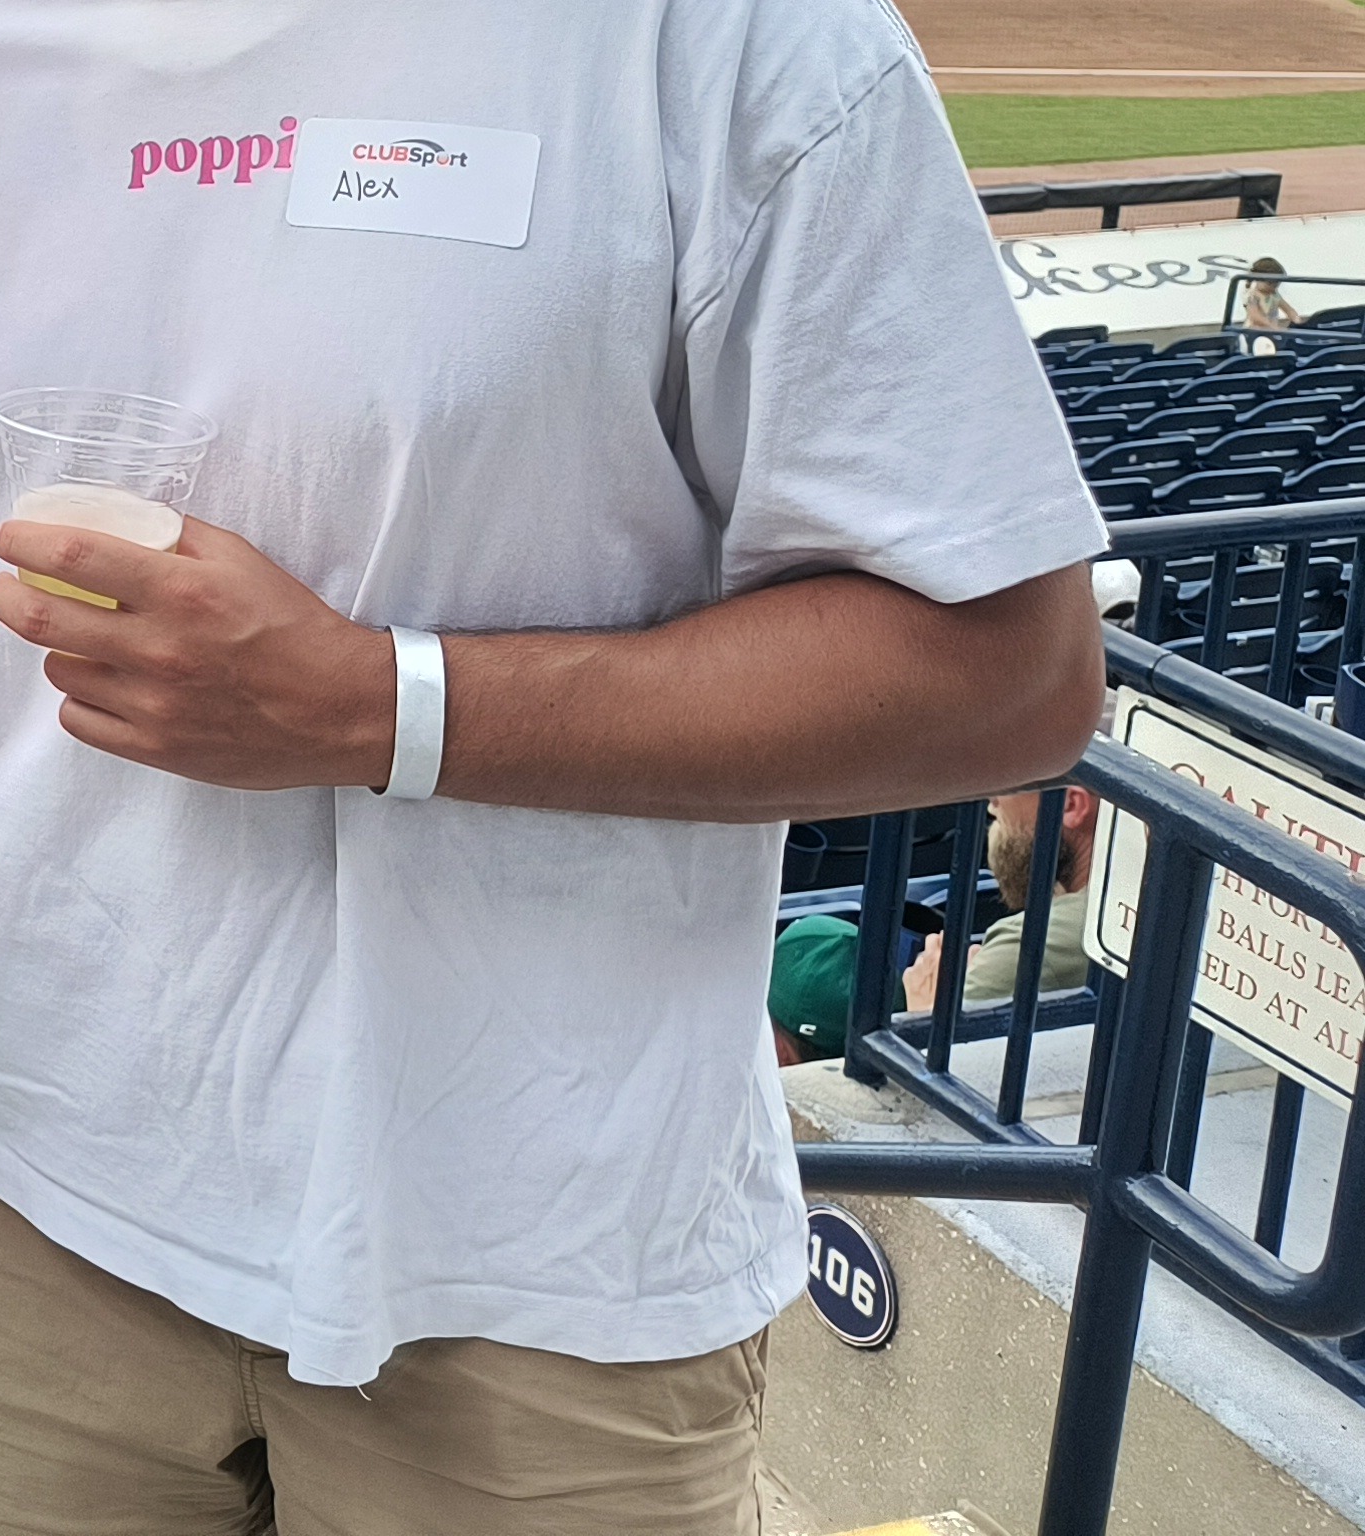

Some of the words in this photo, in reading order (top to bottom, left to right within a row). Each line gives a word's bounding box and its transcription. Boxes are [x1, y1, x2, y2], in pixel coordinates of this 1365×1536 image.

[127, 115, 298, 190] poppi
[332, 169, 400, 202] Alex
[352, 140, 469, 168] CLUBSport
[1217, 908, 1307, 980] BALLS
[1201, 950, 1258, 1001] ELD
[1263, 991, 1308, 1031] AT
[810, 1232, 877, 1319] 106
